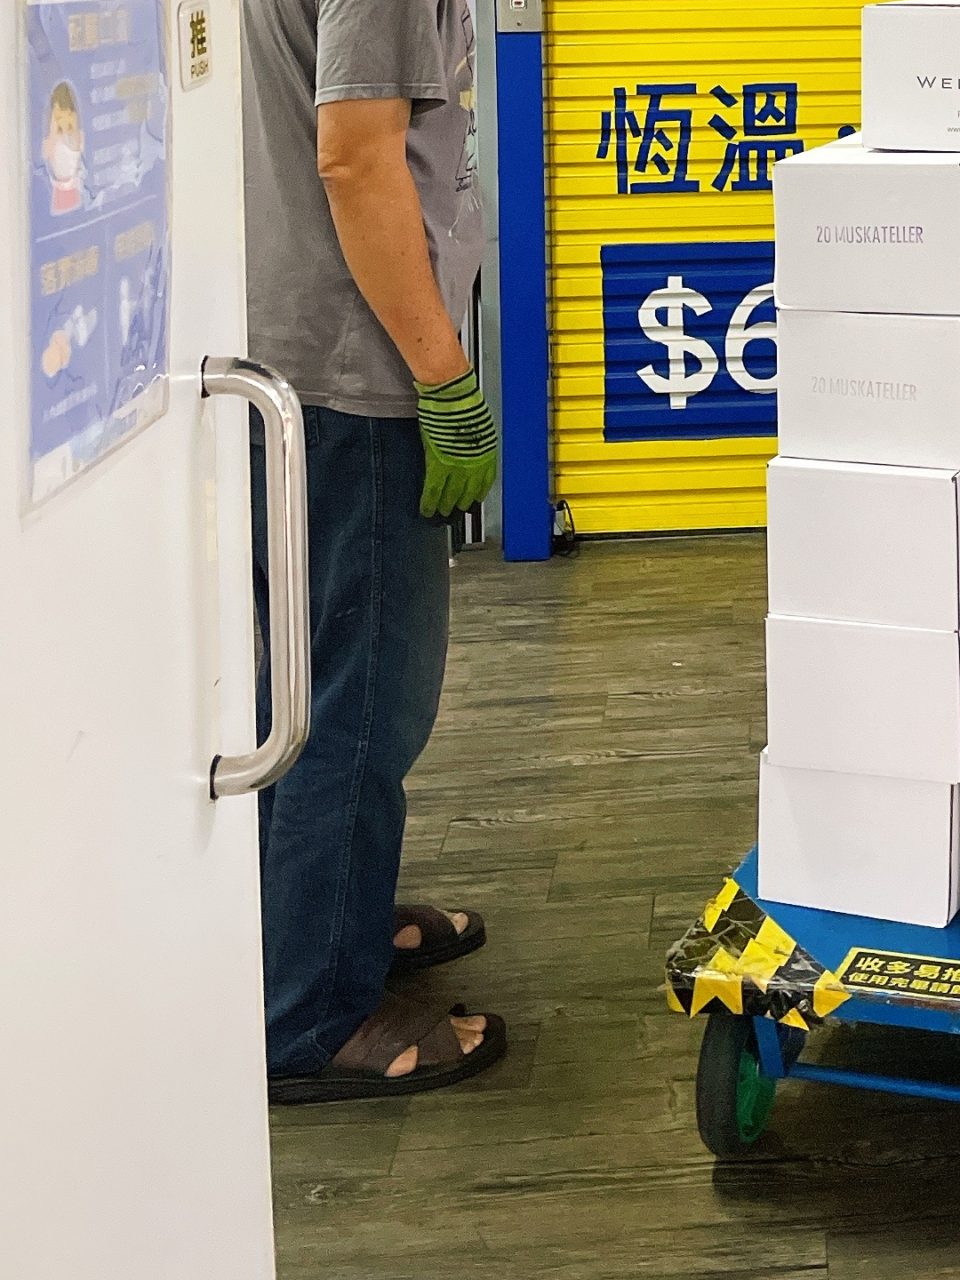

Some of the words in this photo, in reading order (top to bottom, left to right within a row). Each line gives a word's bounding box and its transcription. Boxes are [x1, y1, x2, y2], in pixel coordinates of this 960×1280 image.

[189, 10, 207, 59] 推
[190, 58, 209, 80] PUSH
[816, 225, 832, 244] 20
[835, 225, 924, 245] MUSKATELLER
[811, 375, 826, 394] 20
[829, 377, 917, 401] MUSKATELLER
